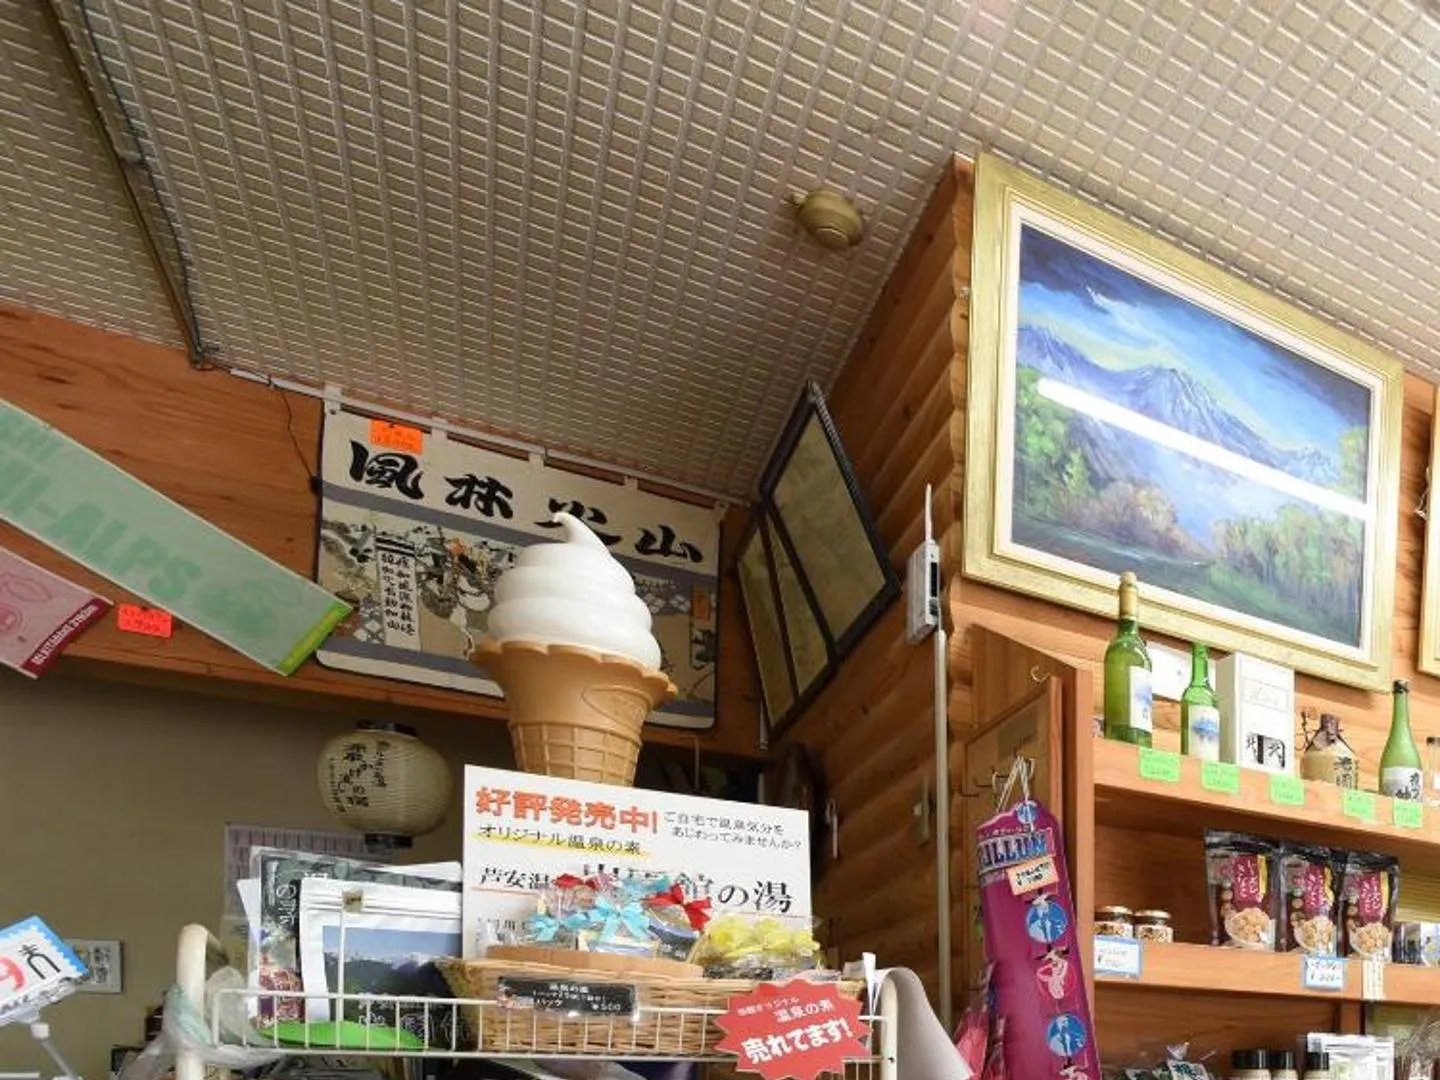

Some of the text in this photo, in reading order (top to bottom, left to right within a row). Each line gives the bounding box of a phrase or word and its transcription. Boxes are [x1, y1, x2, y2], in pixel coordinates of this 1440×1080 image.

[475, 785, 658, 835] 好評発売中!
[479, 824, 643, 856] オリジナル温泉の素
[479, 863, 796, 914] 芦安温 館の湯
[776, 999, 836, 1023] 温泉の素
[742, 1018, 854, 1065] 売れてます!
